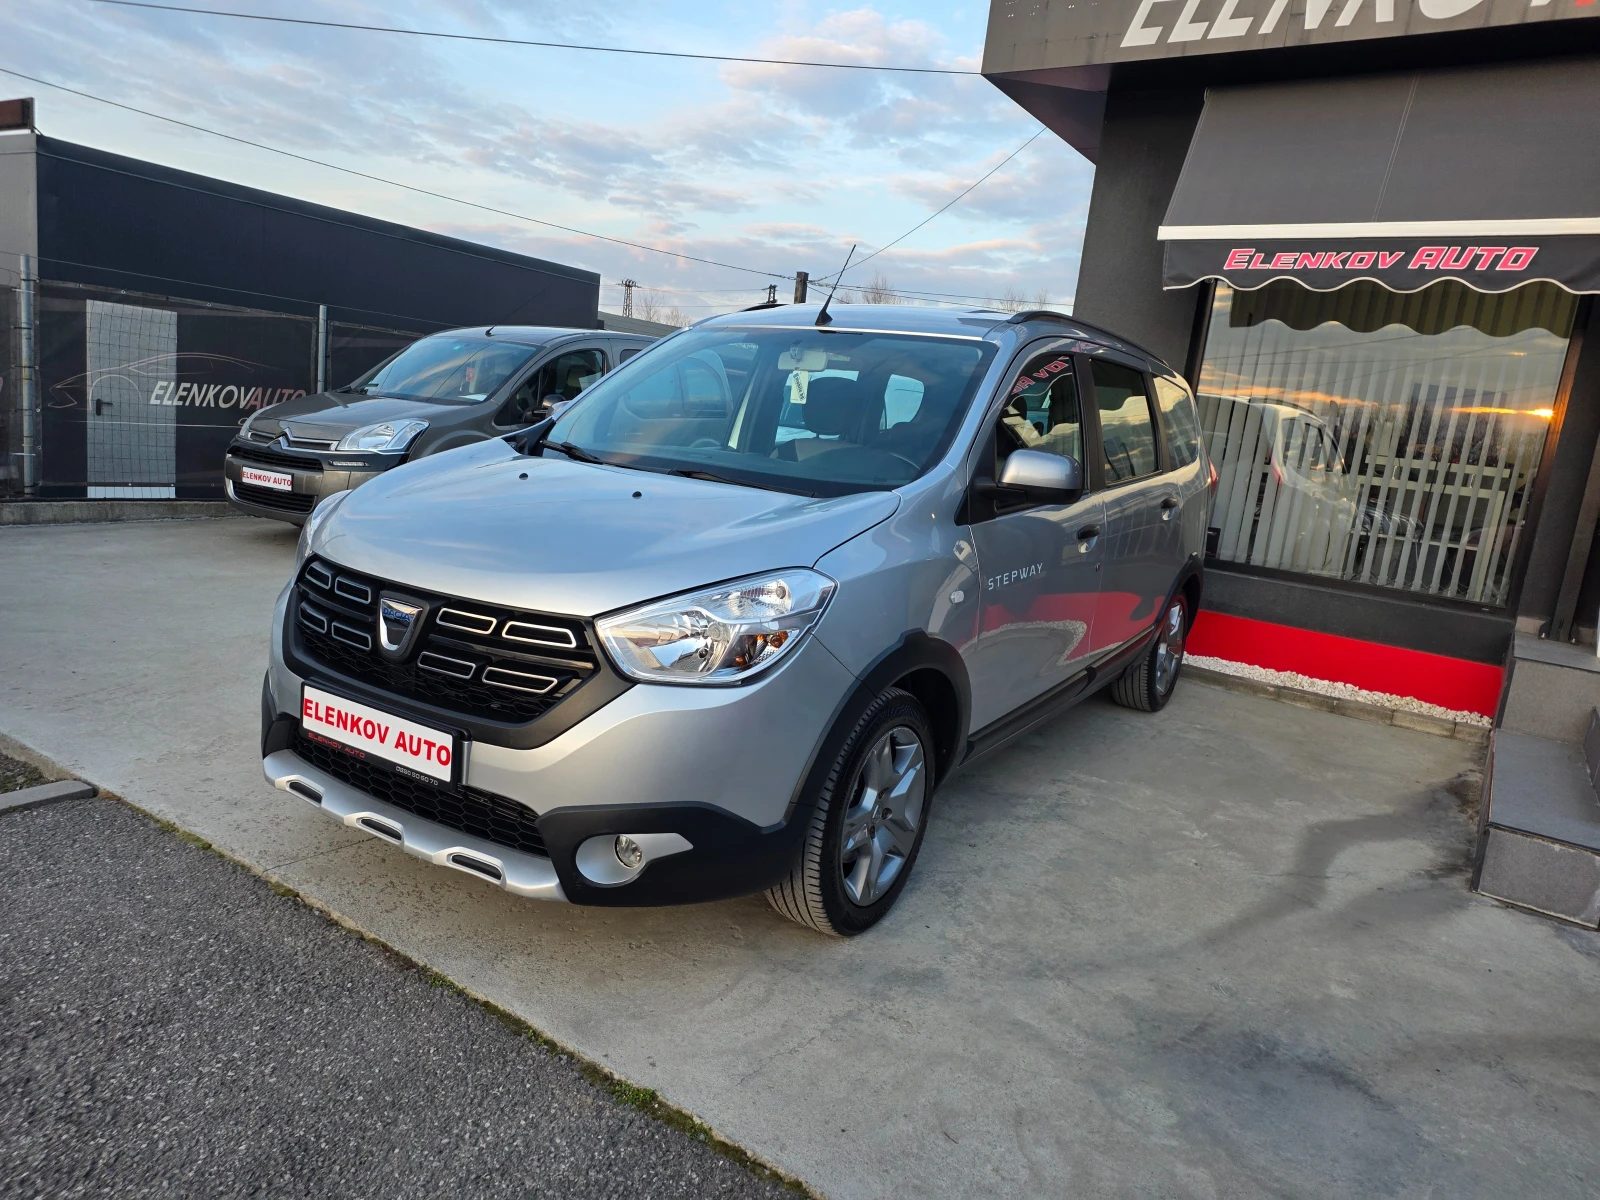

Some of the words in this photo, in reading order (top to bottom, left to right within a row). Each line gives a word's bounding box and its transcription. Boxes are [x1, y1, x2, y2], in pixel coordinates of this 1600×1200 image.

[1223, 248, 1405, 270] ELENKOV
[1408, 246, 1539, 271] AUTO
[242, 471, 272, 483] ELENKOV
[273, 477, 292, 487] AUTO
[988, 563, 1043, 590] STEPWAY
[383, 608, 410, 622] DACIA
[303, 698, 390, 744] ELENKOV
[394, 731, 451, 766] AUTO
[344, 747, 366, 759] AUTO
[430, 778, 438, 786] 70
